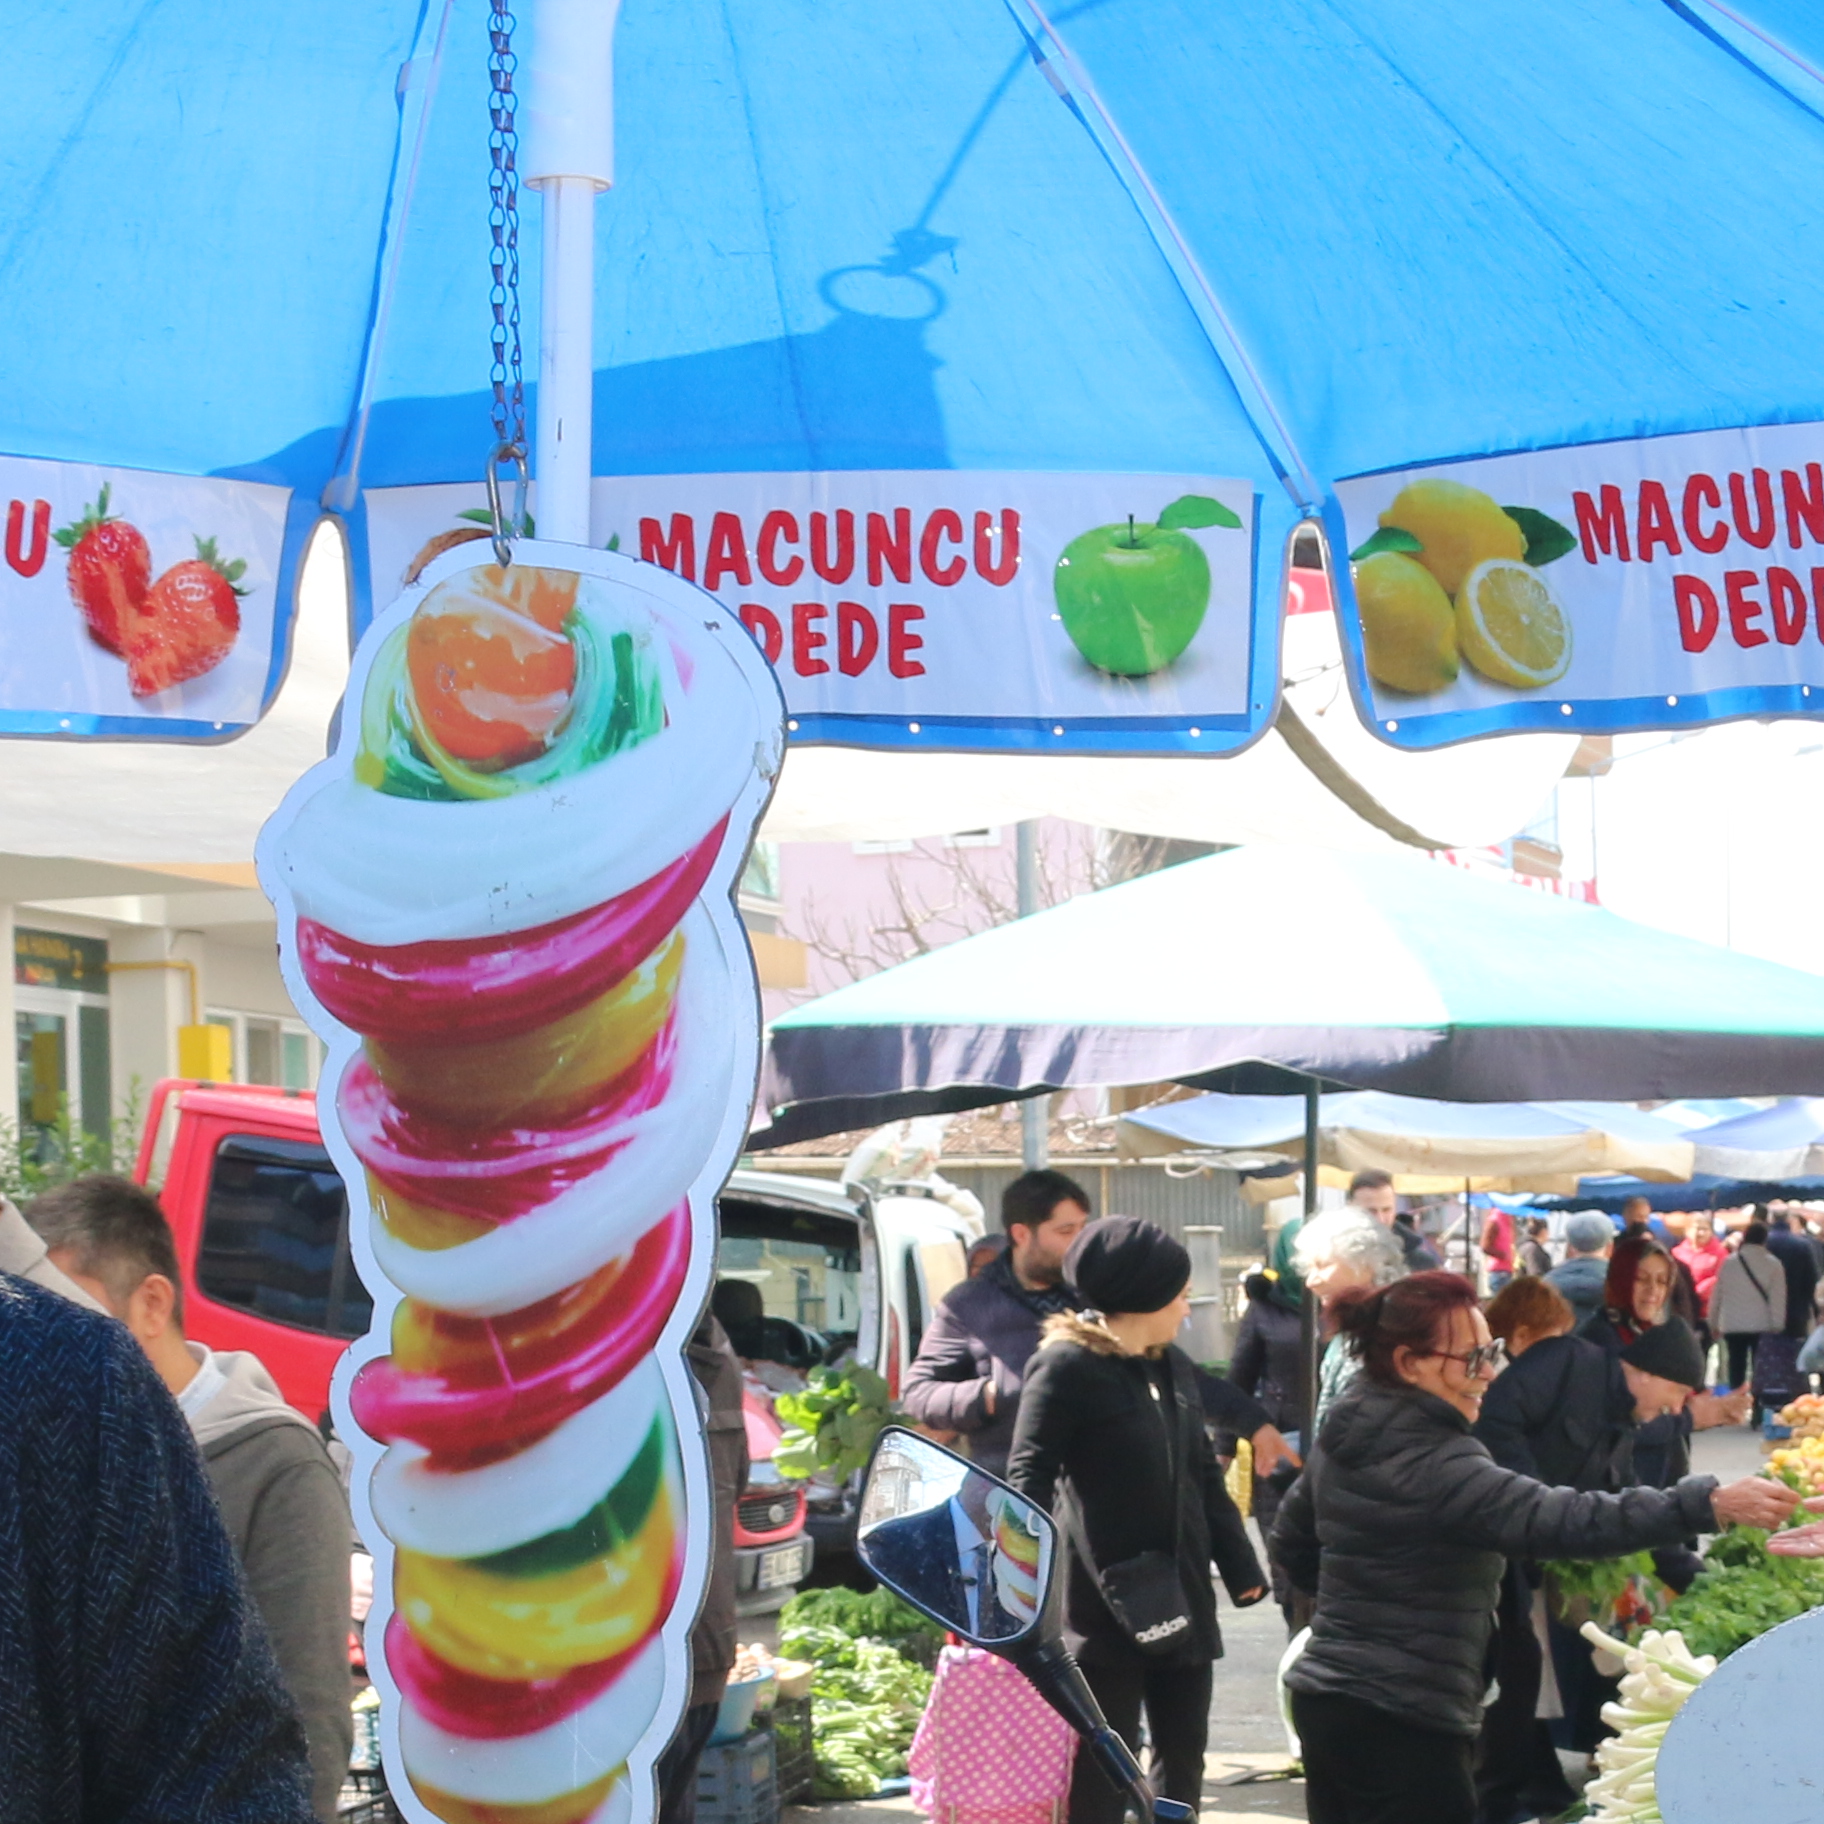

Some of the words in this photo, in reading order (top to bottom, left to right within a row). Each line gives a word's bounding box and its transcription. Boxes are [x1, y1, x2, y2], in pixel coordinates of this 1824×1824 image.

[639, 507, 1022, 591] MACUNCU
[738, 601, 927, 679] DEDE
[1135, 1615, 1189, 1644] adidas
